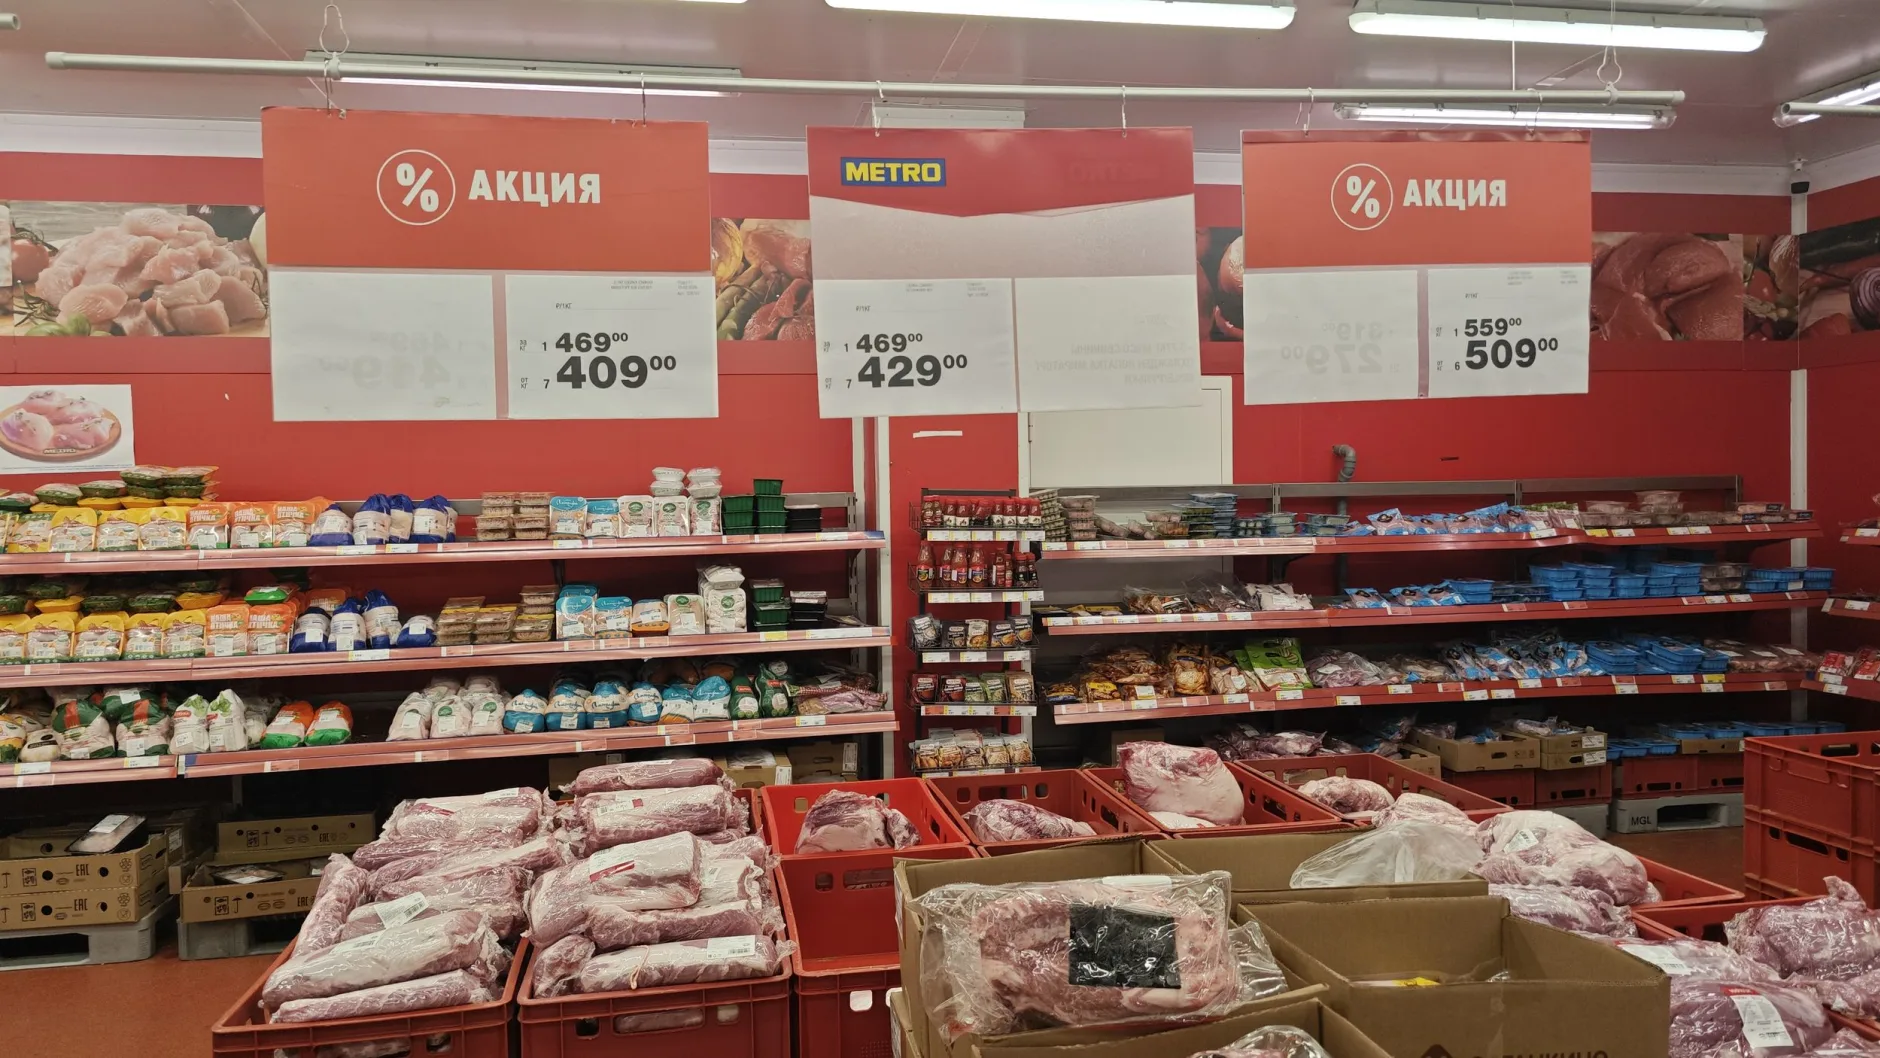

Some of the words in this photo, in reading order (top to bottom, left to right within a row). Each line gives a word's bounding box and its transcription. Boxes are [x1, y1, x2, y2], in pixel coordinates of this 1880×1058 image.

[845, 162, 941, 182] METRO
[468, 169, 601, 207] АКЦИЯ
[1402, 179, 1507, 211] АКЦИЯ
[1454, 328, 1458, 337] 1
[542, 342, 547, 351] 1
[844, 343, 849, 352] 1
[1454, 362, 1460, 371] 6
[543, 379, 550, 389] 7
[846, 379, 852, 388] 7
[1631, 816, 1652, 826] MGL
[76, 864, 90, 877] EAC
[74, 898, 88, 912] EAC
